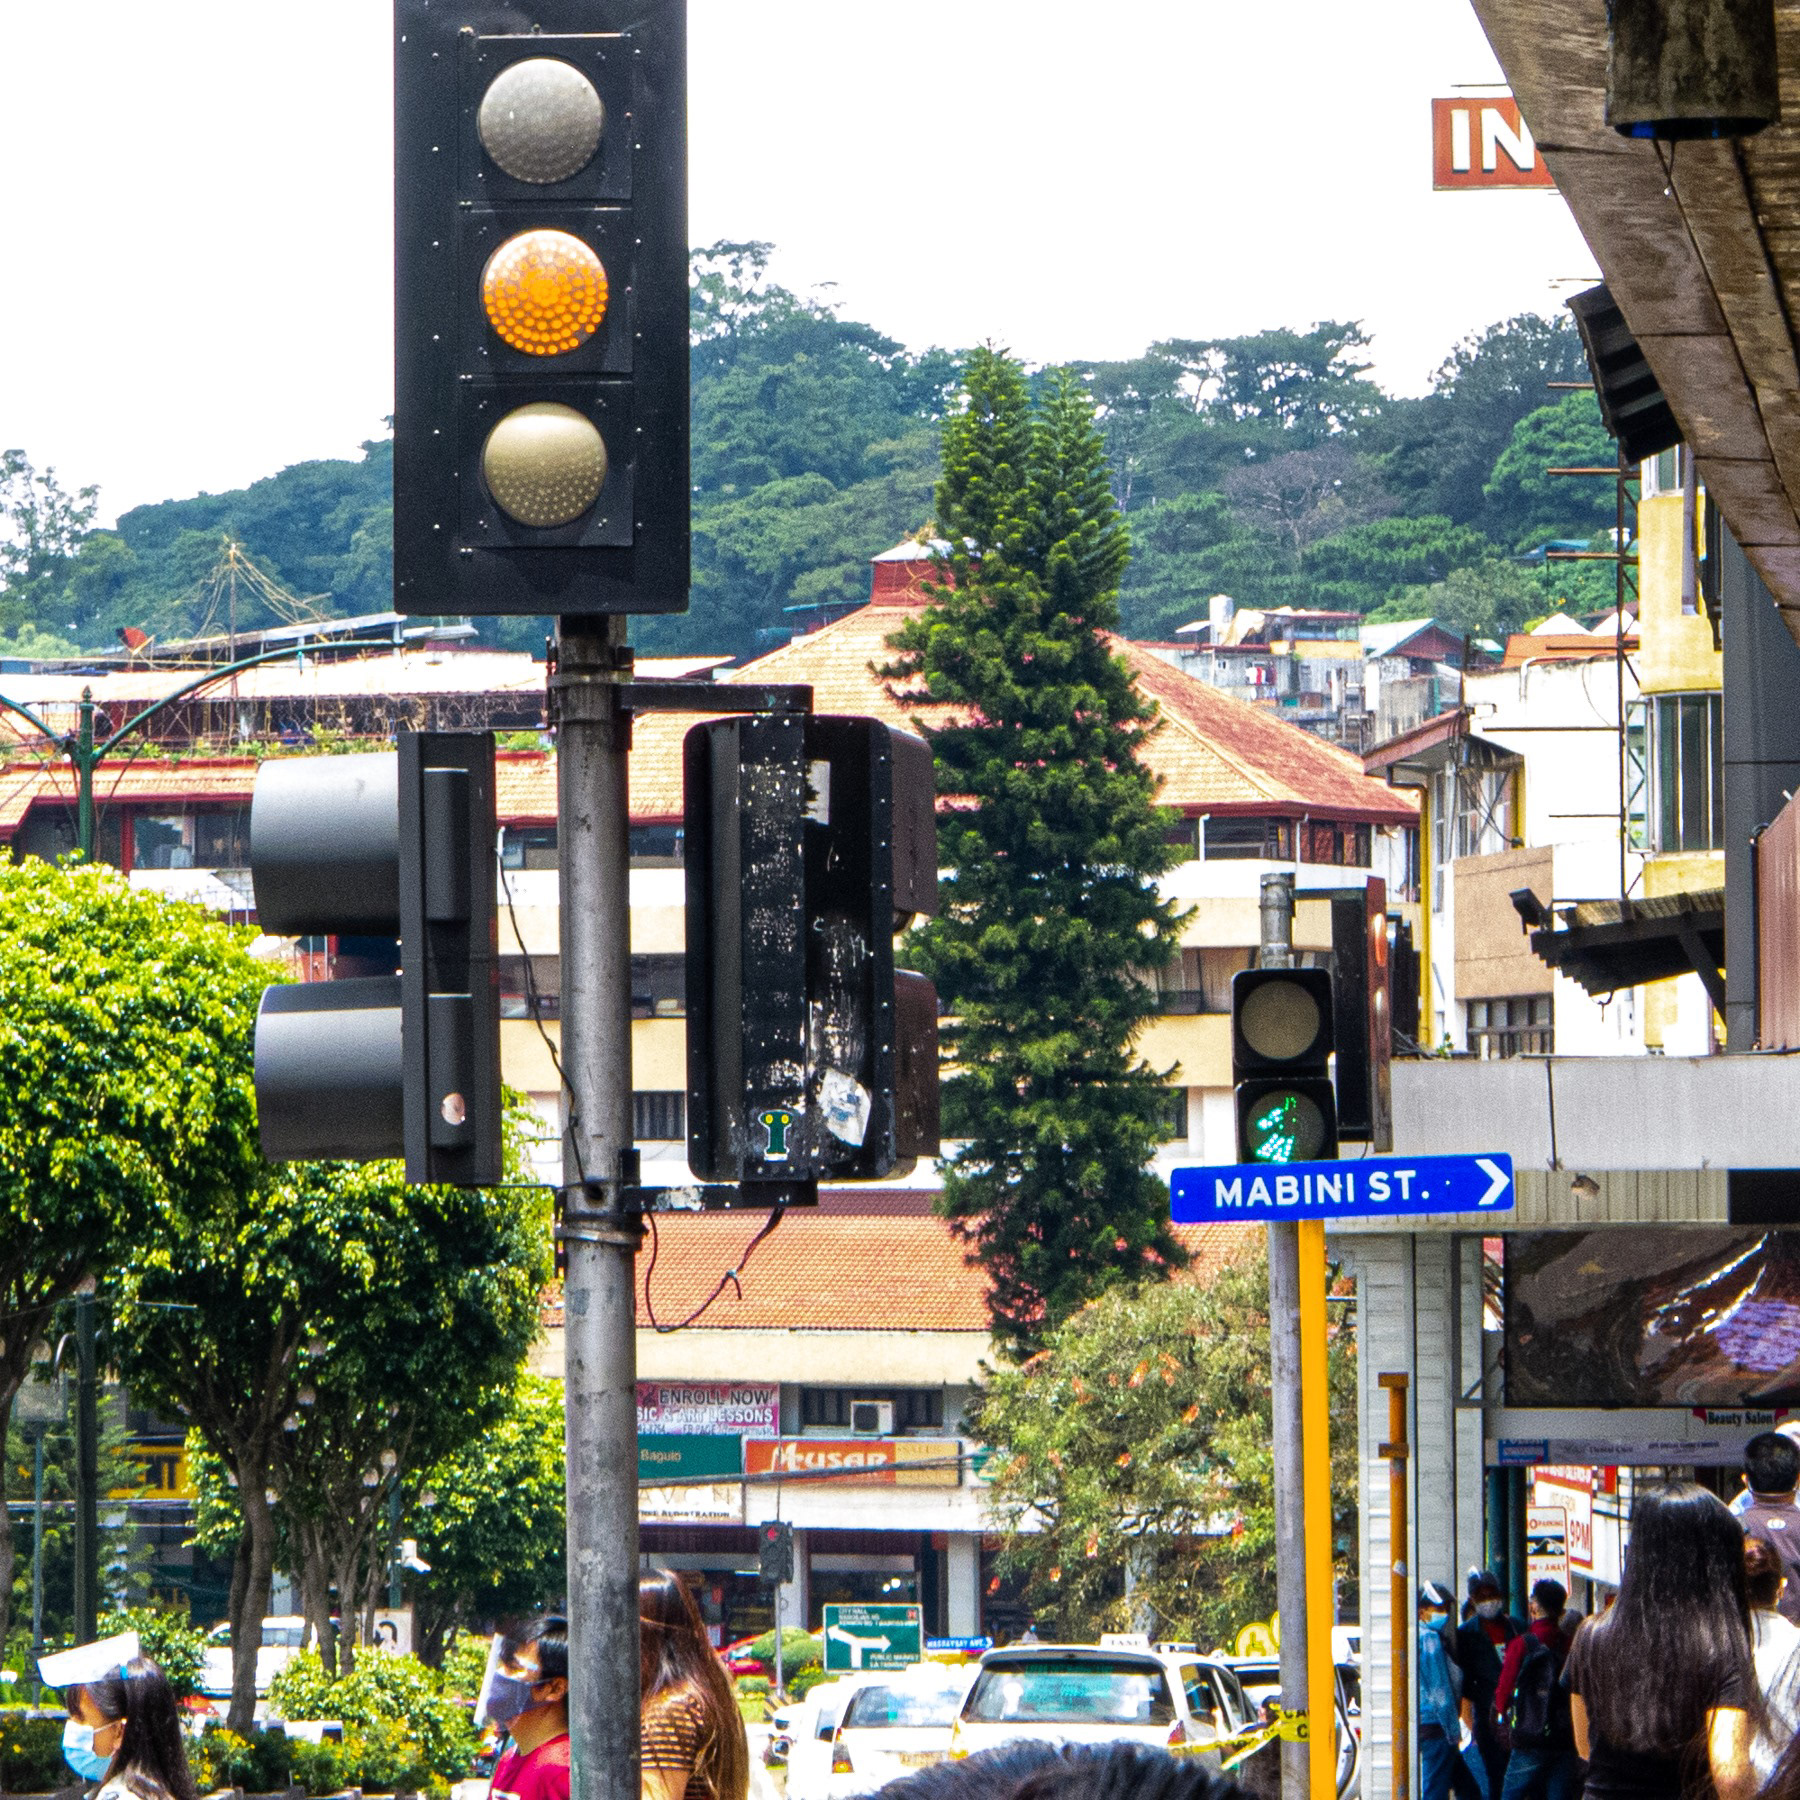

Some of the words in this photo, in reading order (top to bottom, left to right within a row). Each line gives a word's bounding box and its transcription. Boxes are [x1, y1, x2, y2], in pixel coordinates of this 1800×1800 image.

[1214, 1172, 1355, 1208] MABINI
[1367, 1169, 1430, 1202] ST.
[659, 1388, 725, 1406] ENROLL
[662, 1406, 674, 1422] &
[678, 1407, 706, 1423] ART
[709, 1407, 774, 1423] LESSONS
[1707, 1411, 1742, 1427] Beauty
[1745, 1409, 1773, 1424] Salon
[641, 1448, 682, 1464] Baguio
[1569, 1519, 1591, 1552] 9PM
